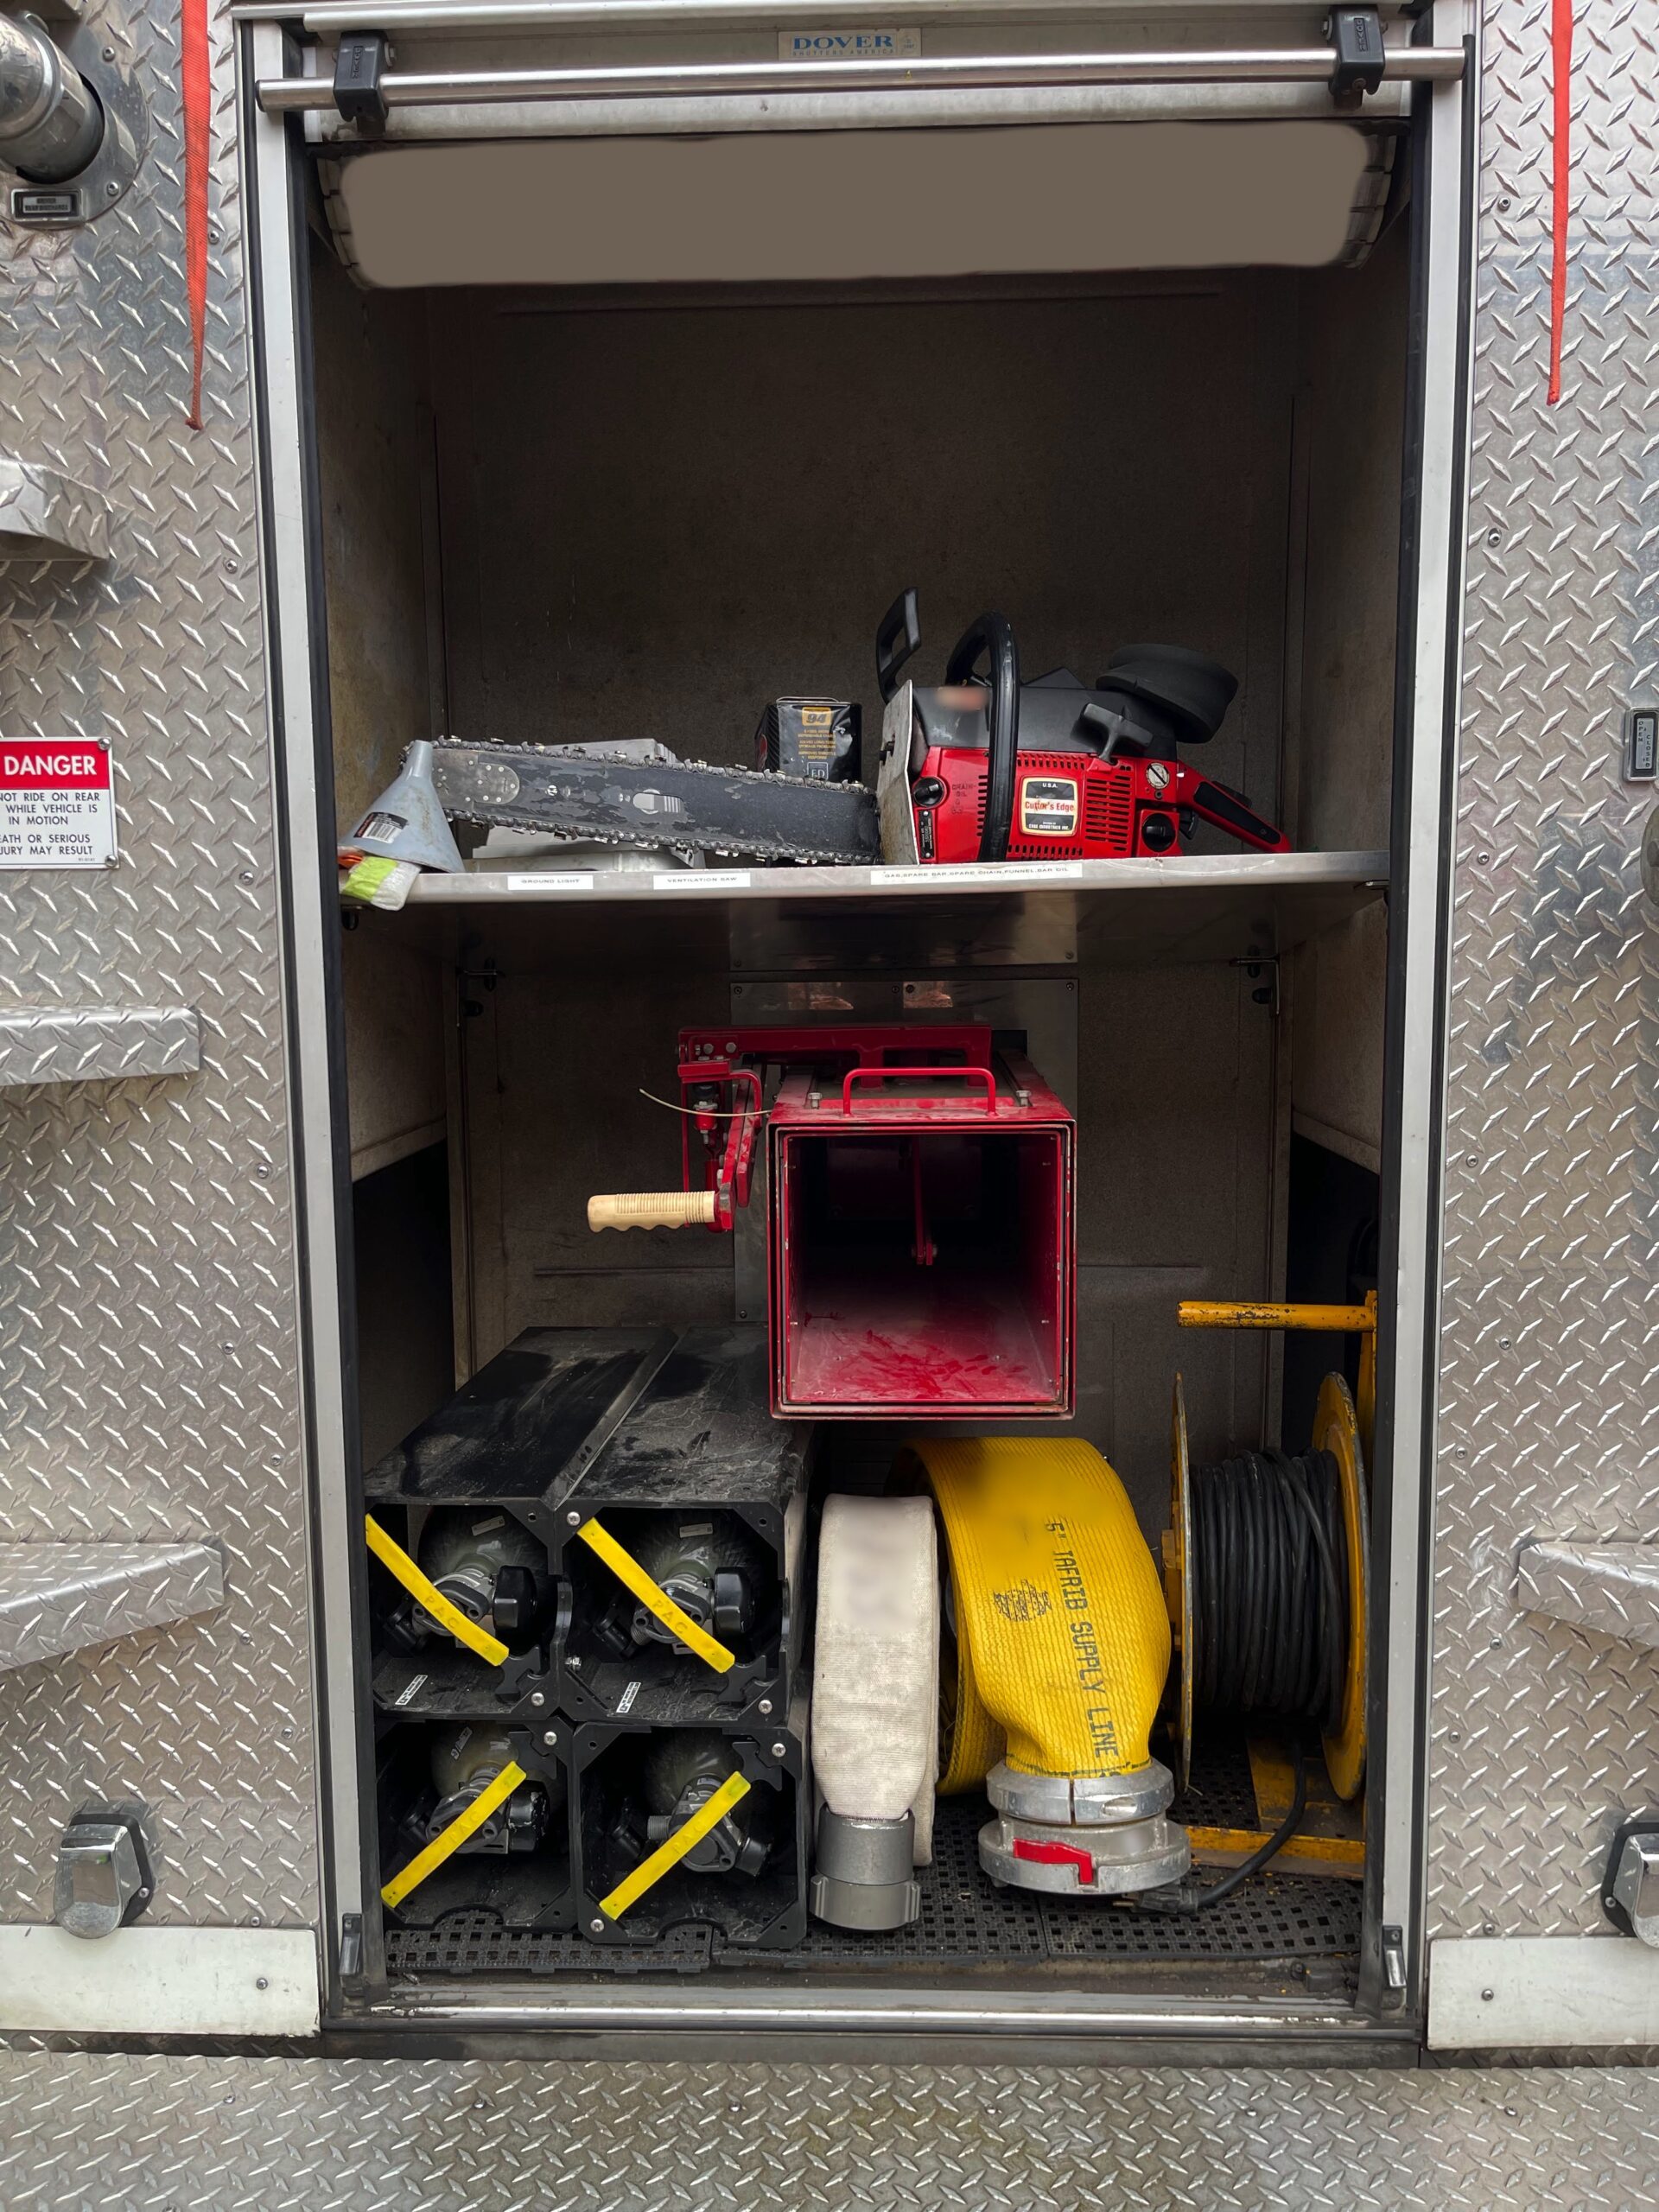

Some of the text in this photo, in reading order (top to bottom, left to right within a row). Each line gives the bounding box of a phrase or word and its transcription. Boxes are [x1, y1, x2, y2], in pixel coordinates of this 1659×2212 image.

[793, 35, 893, 50] DOVER
[806, 714, 827, 723] 94
[3, 755, 97, 776] DANGER
[24, 792, 46, 802] RIDE
[52, 792, 68, 802] ON
[75, 792, 100, 802] REAR
[6, 804, 98, 814] WHILE VEHICLE IS
[1056, 803, 1074, 812] Edge
[9, 817, 69, 825] IN MOTION
[28, 835, 42, 843] OR
[48, 835, 91, 843] SERIOUS
[29, 846, 53, 855] MAY
[59, 846, 93, 855] RESULT
[652, 1599, 688, 1634] PAC
[1070, 1621, 1106, 1694] SUPPLY
[1087, 1707, 1119, 1758] LINE
